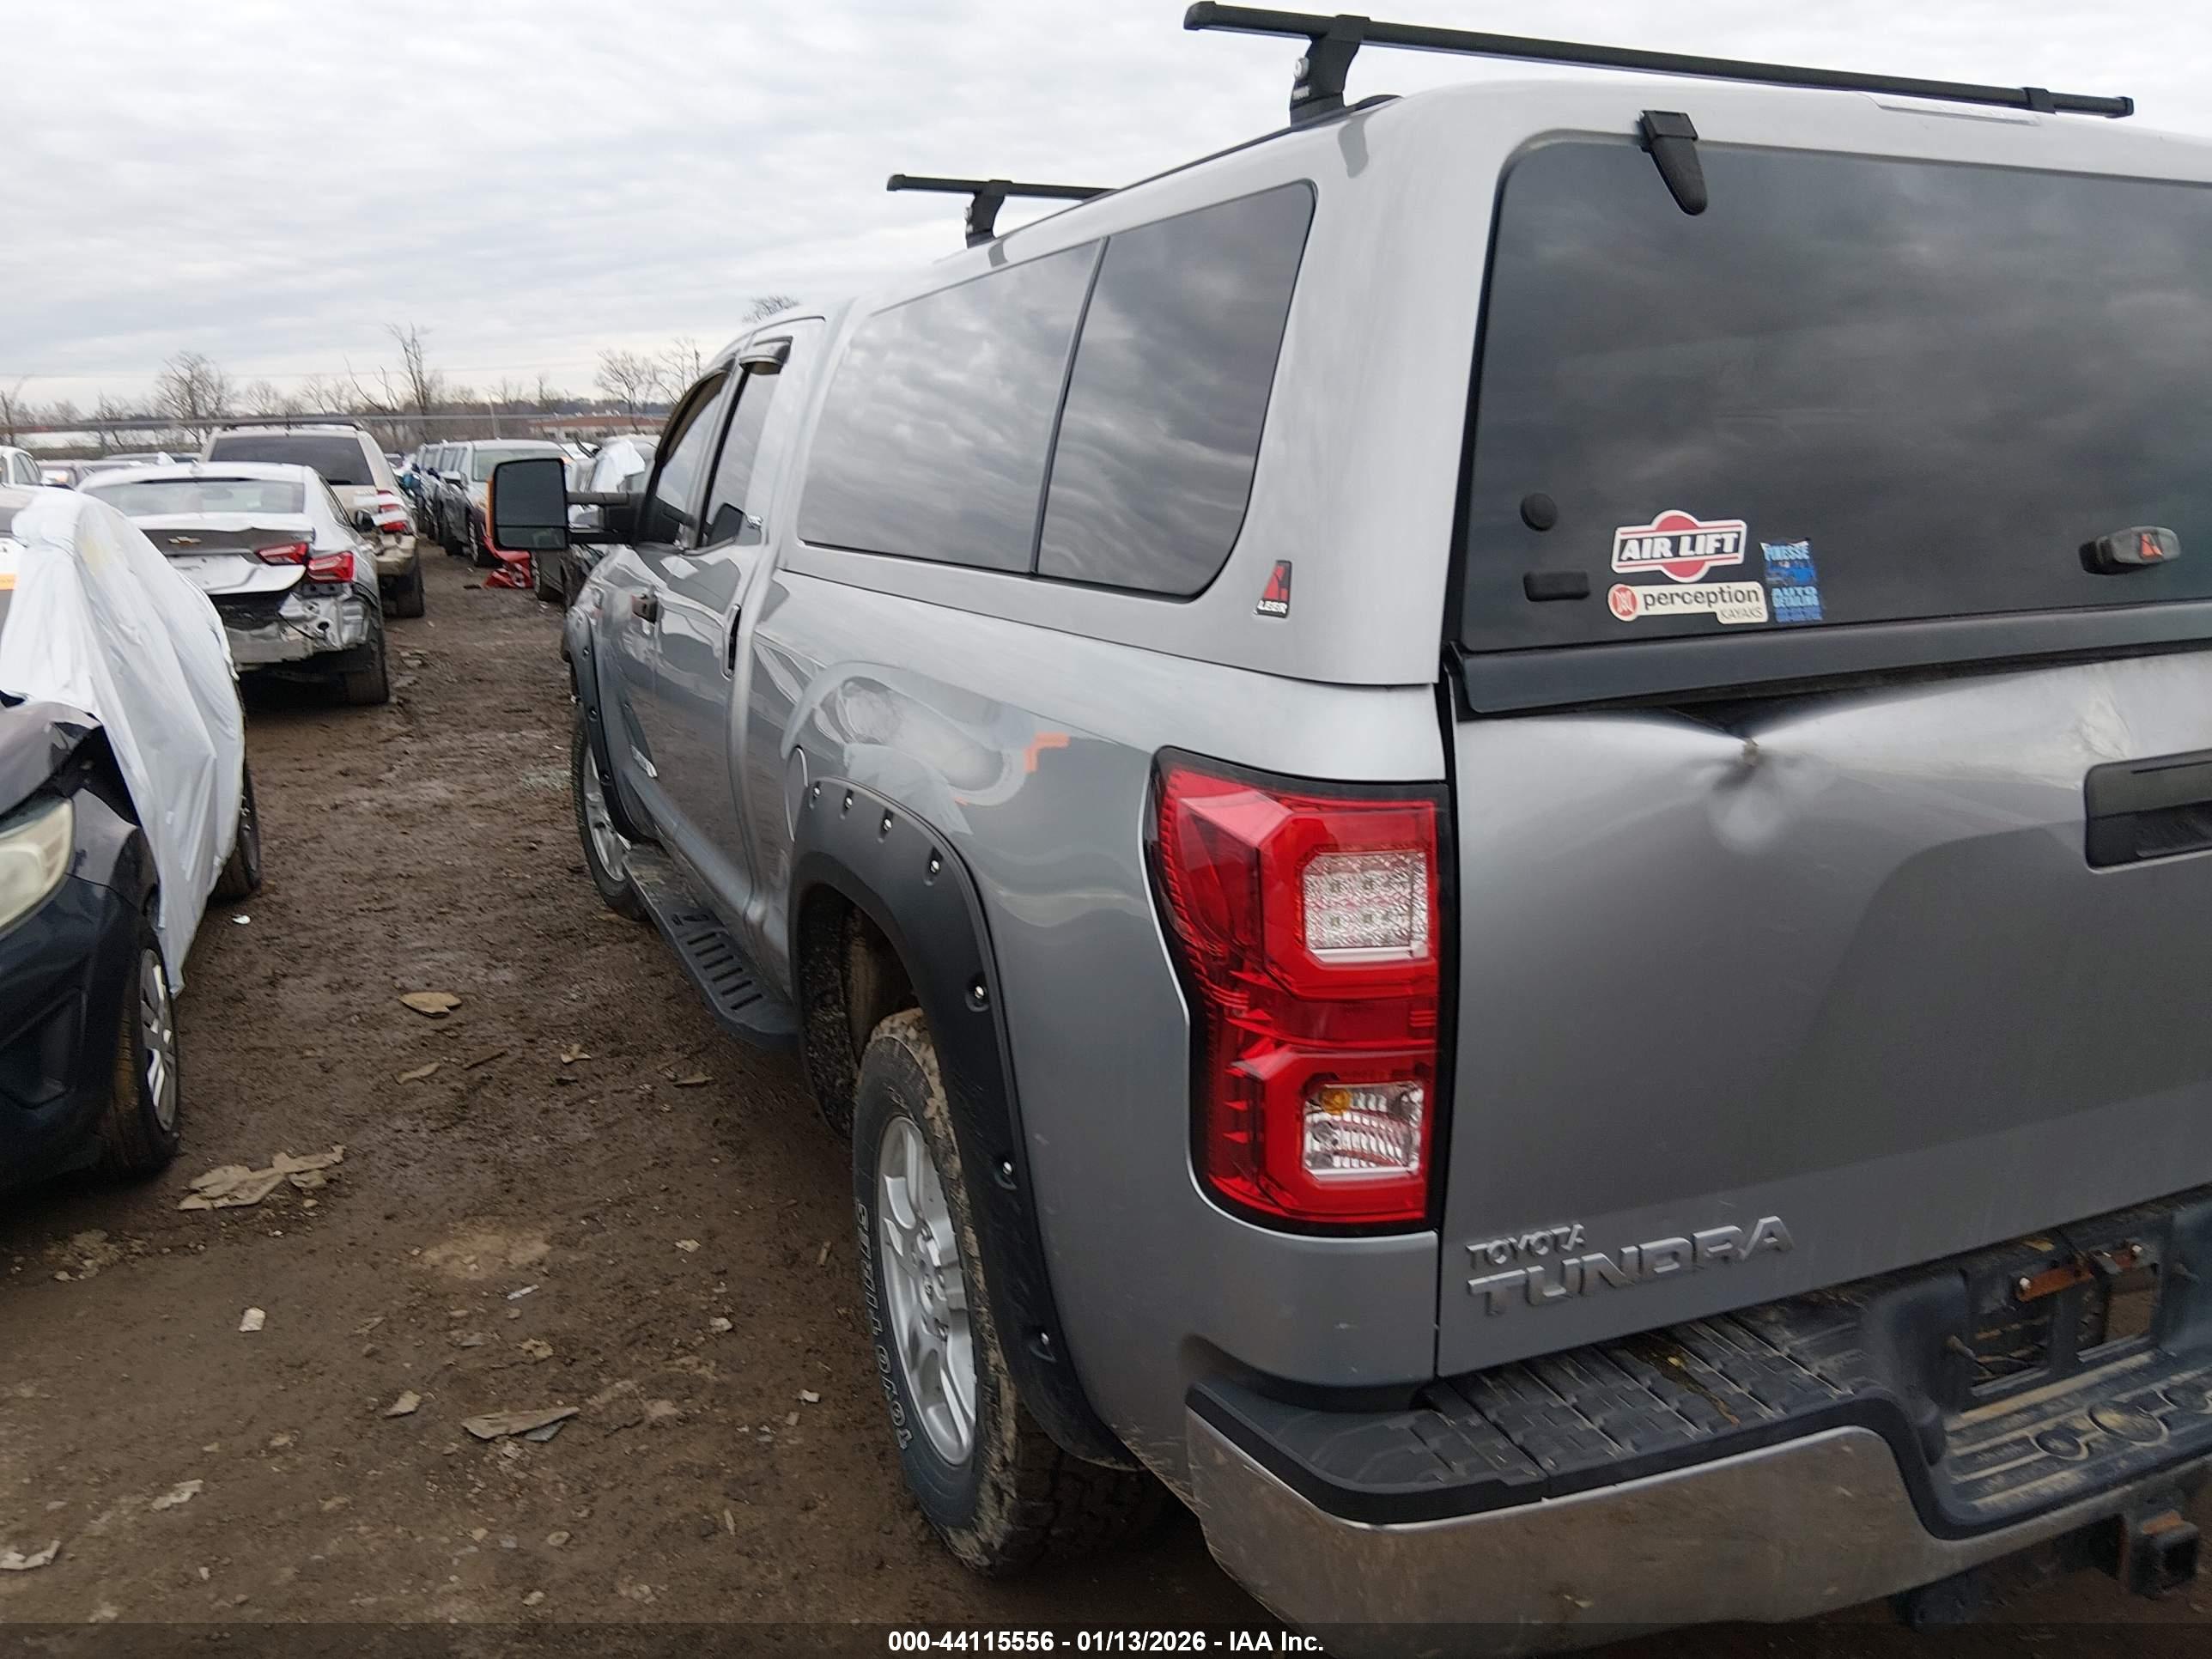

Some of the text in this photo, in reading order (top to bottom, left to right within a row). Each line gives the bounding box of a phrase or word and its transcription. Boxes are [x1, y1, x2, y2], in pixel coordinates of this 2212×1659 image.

[1621, 538, 1674, 561] AIR
[1679, 532, 1738, 556] LIFT
[1642, 586, 1760, 611] perception
[1466, 1223, 1587, 1269] TOYOTA
[1467, 1215, 1796, 1316] TUNDRA
[857, 1202, 913, 1449] TOYO TIRES
